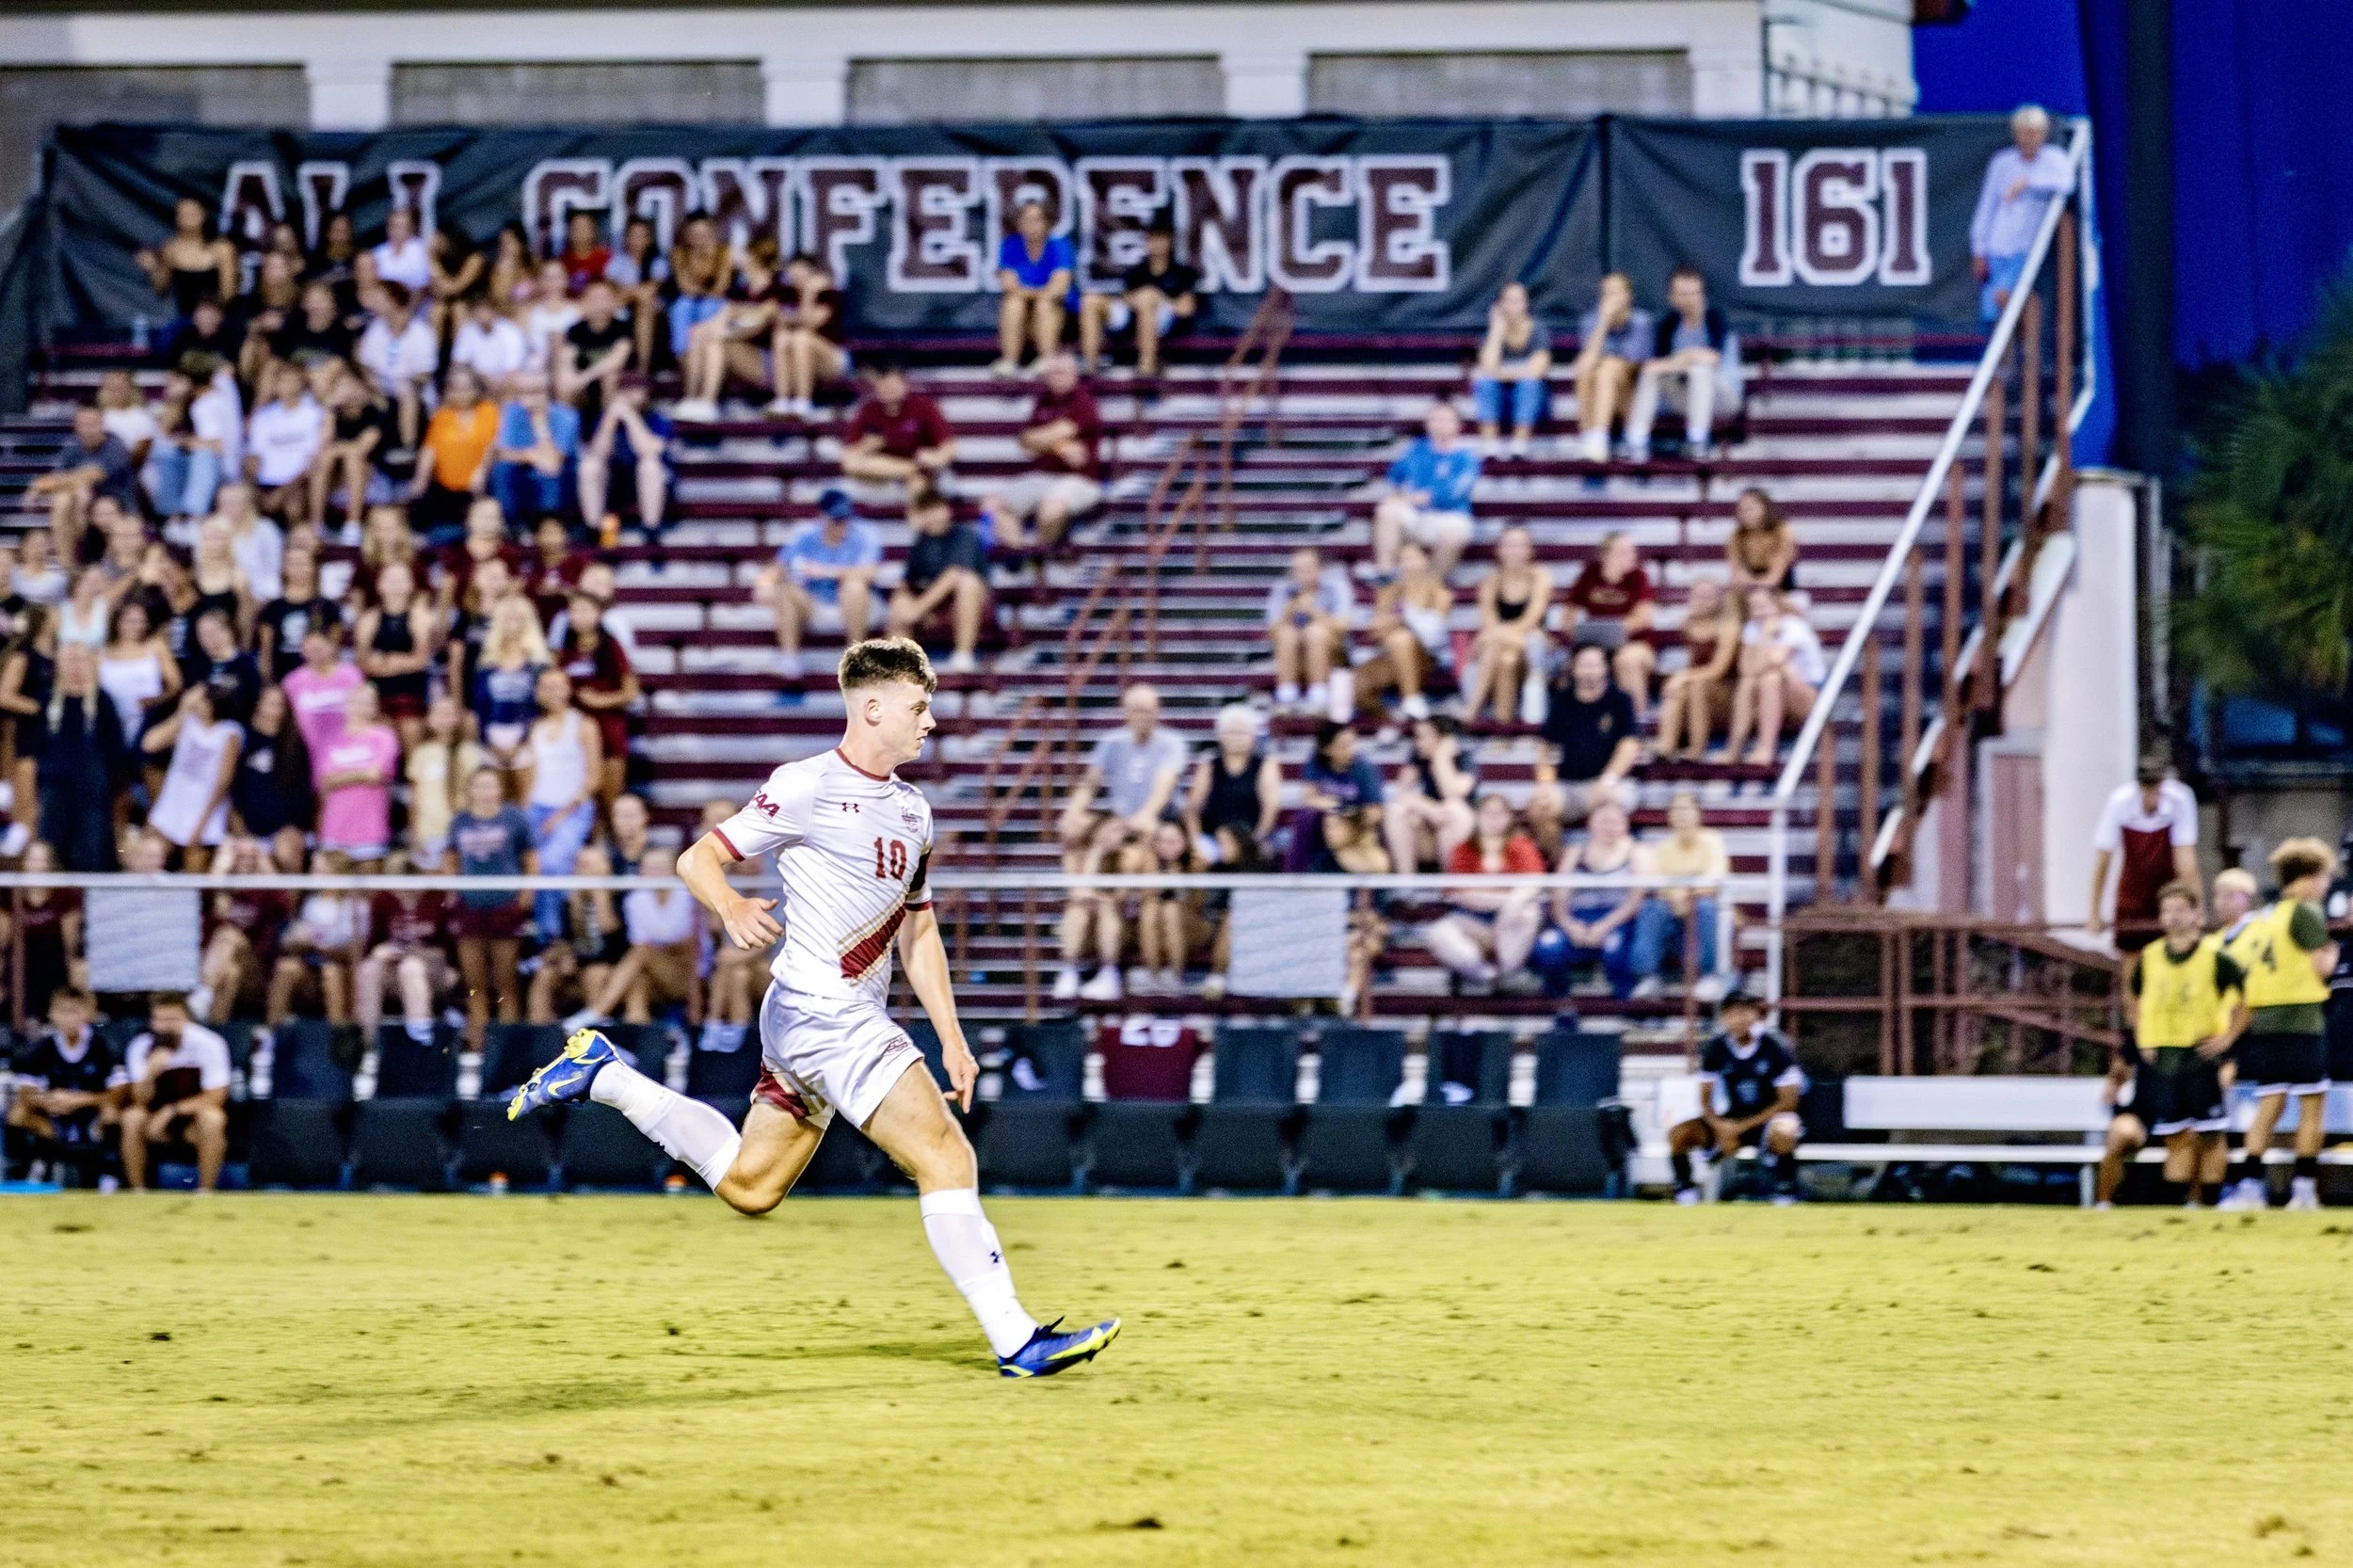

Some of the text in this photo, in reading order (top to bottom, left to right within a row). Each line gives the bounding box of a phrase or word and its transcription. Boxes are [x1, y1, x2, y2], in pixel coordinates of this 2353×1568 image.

[1739, 148, 1932, 286] 161
[754, 790, 781, 818] AA
[873, 837, 906, 881] 10
